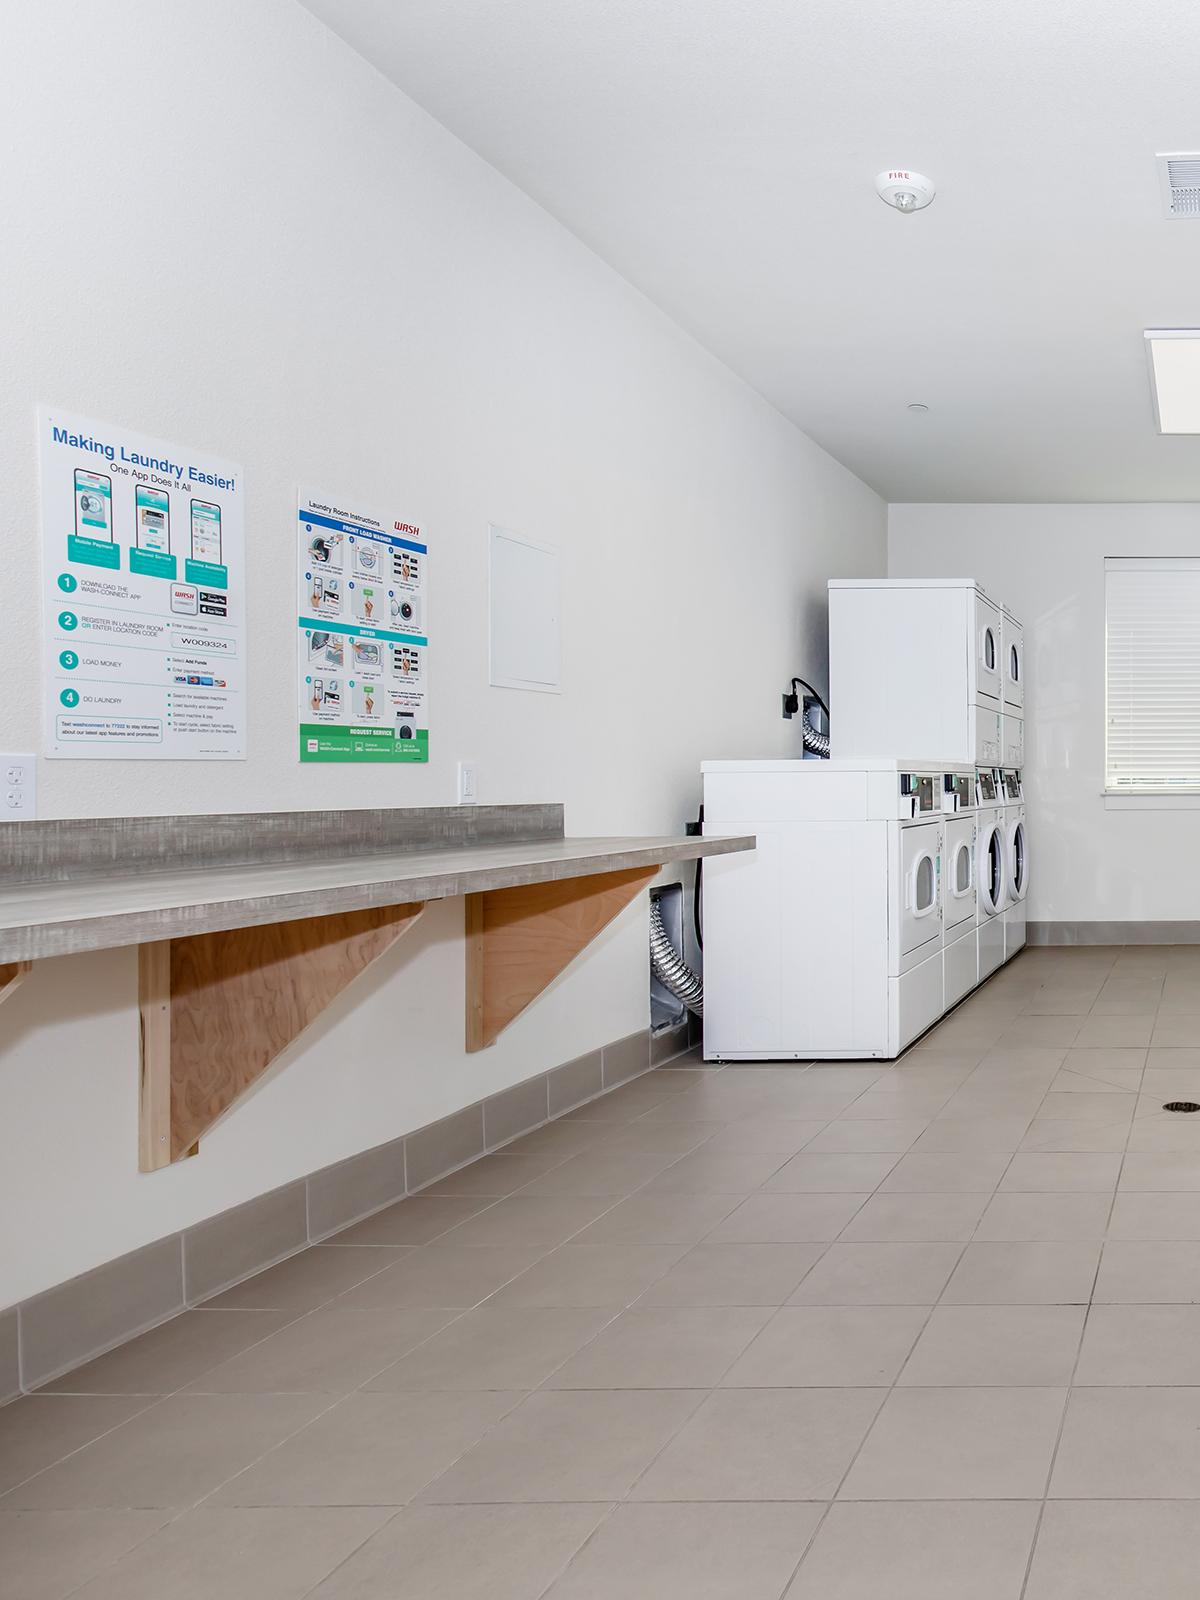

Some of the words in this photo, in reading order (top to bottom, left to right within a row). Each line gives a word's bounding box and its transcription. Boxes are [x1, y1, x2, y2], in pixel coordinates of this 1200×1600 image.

[53, 427, 114, 460] Making
[121, 447, 183, 479] Laundry
[189, 467, 235, 491] Easier!
[110, 463, 129, 475] One
[132, 470, 148, 481] App
[151, 475, 172, 487] Does
[174, 480, 180, 489] It
[182, 482, 191, 492] All
[309, 500, 331, 514] Laundry
[333, 508, 349, 518] Room
[350, 512, 380, 527] Instructions
[394, 521, 420, 535] WASH
[343, 525, 358, 534] FRONT
[360, 529, 372, 537] LOAD
[372, 533, 392, 542] WASHER
[64, 578, 69, 587] 1
[81, 580, 116, 590] DOWNLOAD
[81, 587, 128, 598] WASH-CONNECT
[64, 615, 72, 625] 2
[82, 616, 110, 625] REGISTER
[182, 638, 227, 648] W009324
[66, 654, 72, 664] 3
[66, 692, 73, 702] 4
